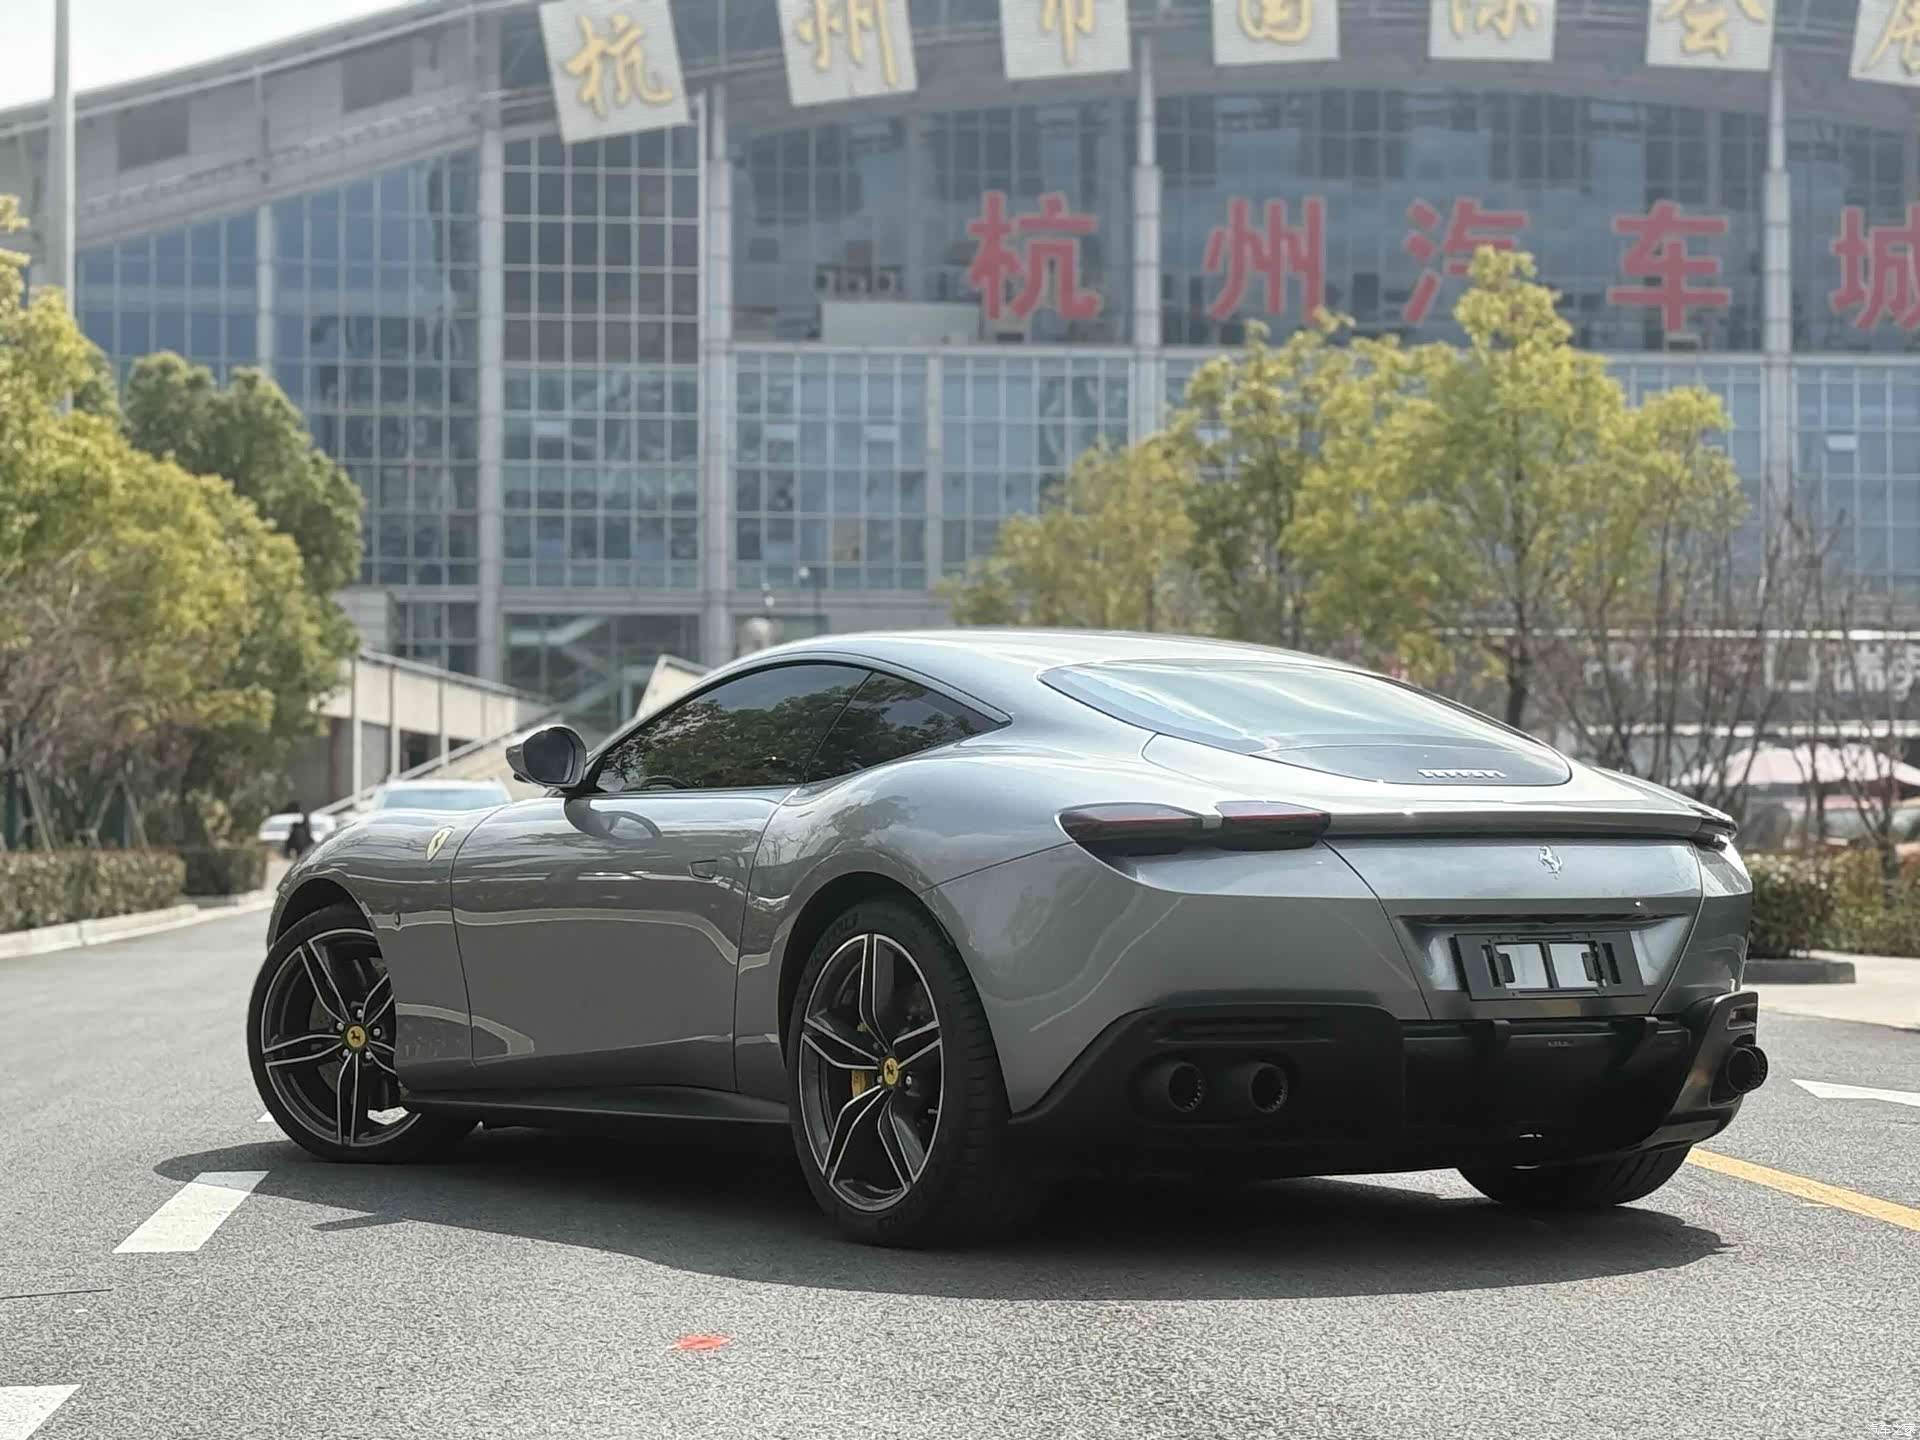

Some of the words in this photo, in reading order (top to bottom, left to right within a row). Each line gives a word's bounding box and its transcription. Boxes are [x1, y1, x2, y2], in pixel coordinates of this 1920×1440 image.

[967, 191, 1920, 332] 杭州汽车城
